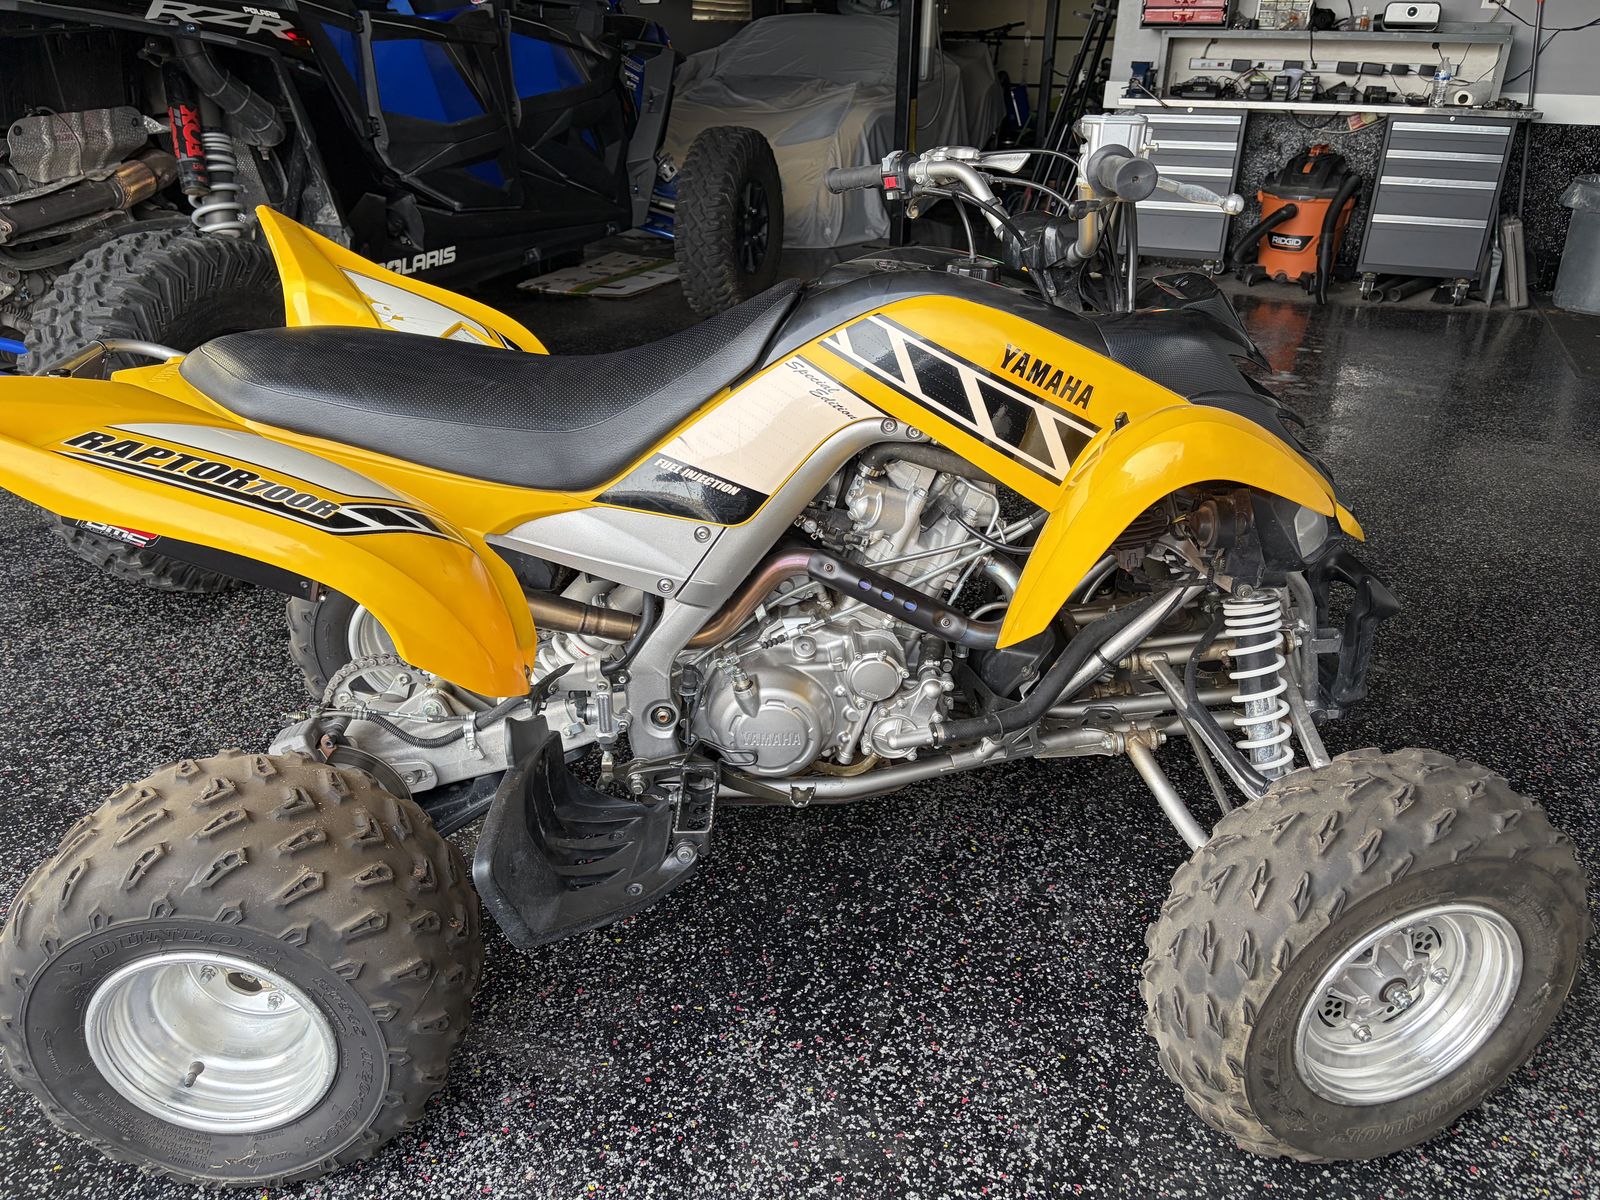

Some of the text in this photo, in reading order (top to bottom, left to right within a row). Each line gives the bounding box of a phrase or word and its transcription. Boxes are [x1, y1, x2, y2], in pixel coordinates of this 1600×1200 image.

[145, 0, 295, 41] RZR
[242, 6, 281, 19] POLARIS
[1272, 236, 1302, 246] RIDGID
[377, 246, 456, 275] OLARIS
[785, 361, 840, 393] Special
[1000, 344, 1095, 410] YAMAHA
[809, 388, 858, 419] Edition
[654, 458, 741, 496] FUEL INJECTION
[742, 731, 801, 746] YAMAHA
